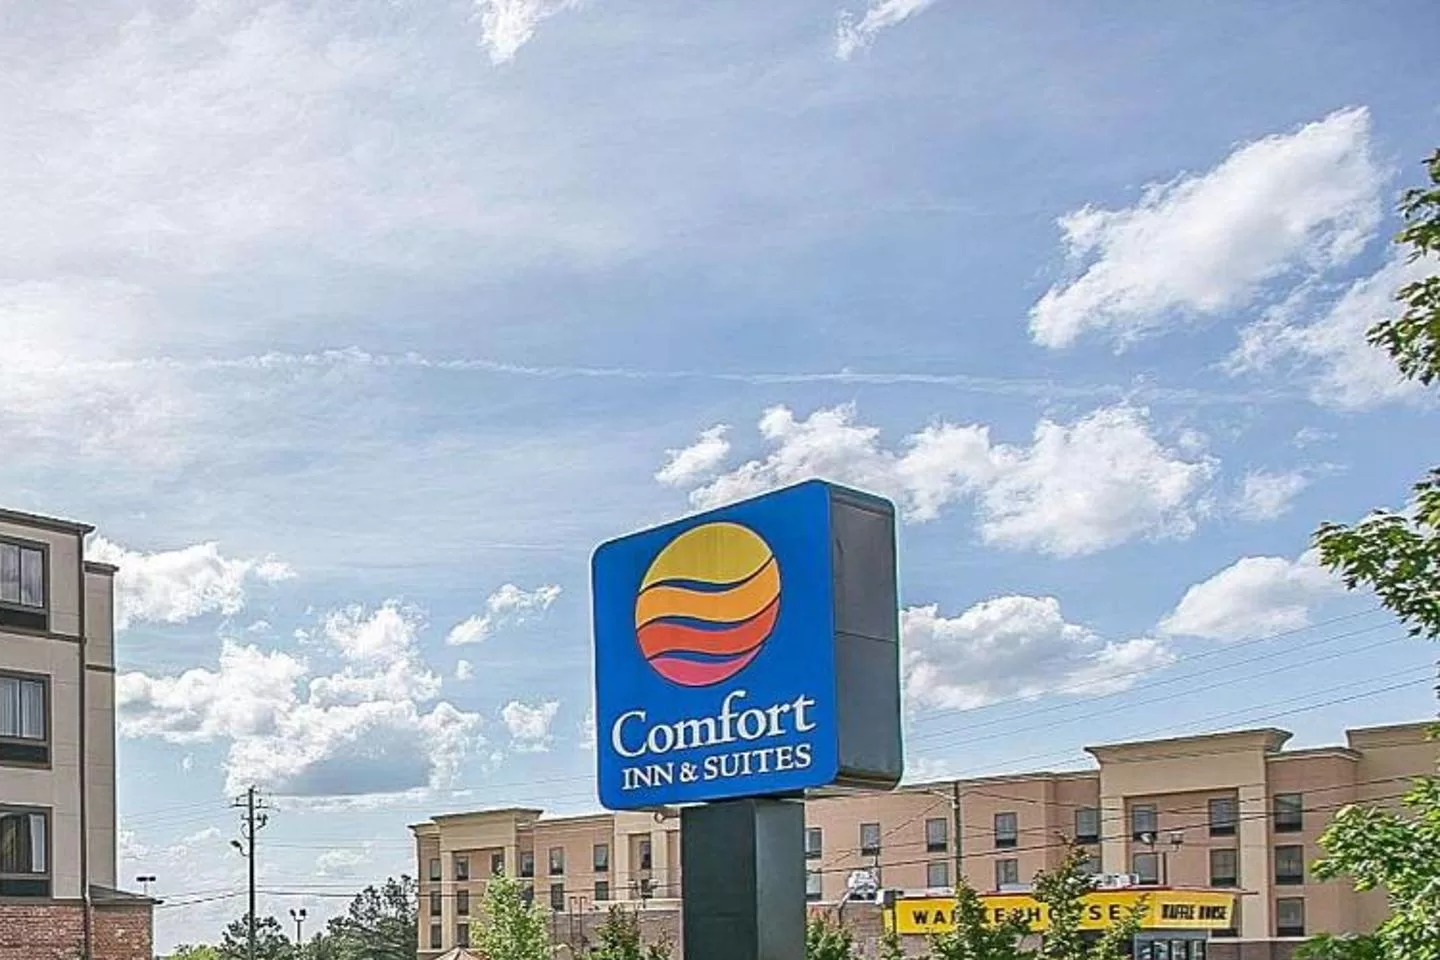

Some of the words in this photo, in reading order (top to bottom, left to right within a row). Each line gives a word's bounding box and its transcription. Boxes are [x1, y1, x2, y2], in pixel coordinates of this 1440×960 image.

[612, 690, 816, 758] Comfort
[621, 761, 673, 790] INN
[679, 761, 698, 782] &
[703, 744, 811, 780] SUITES
